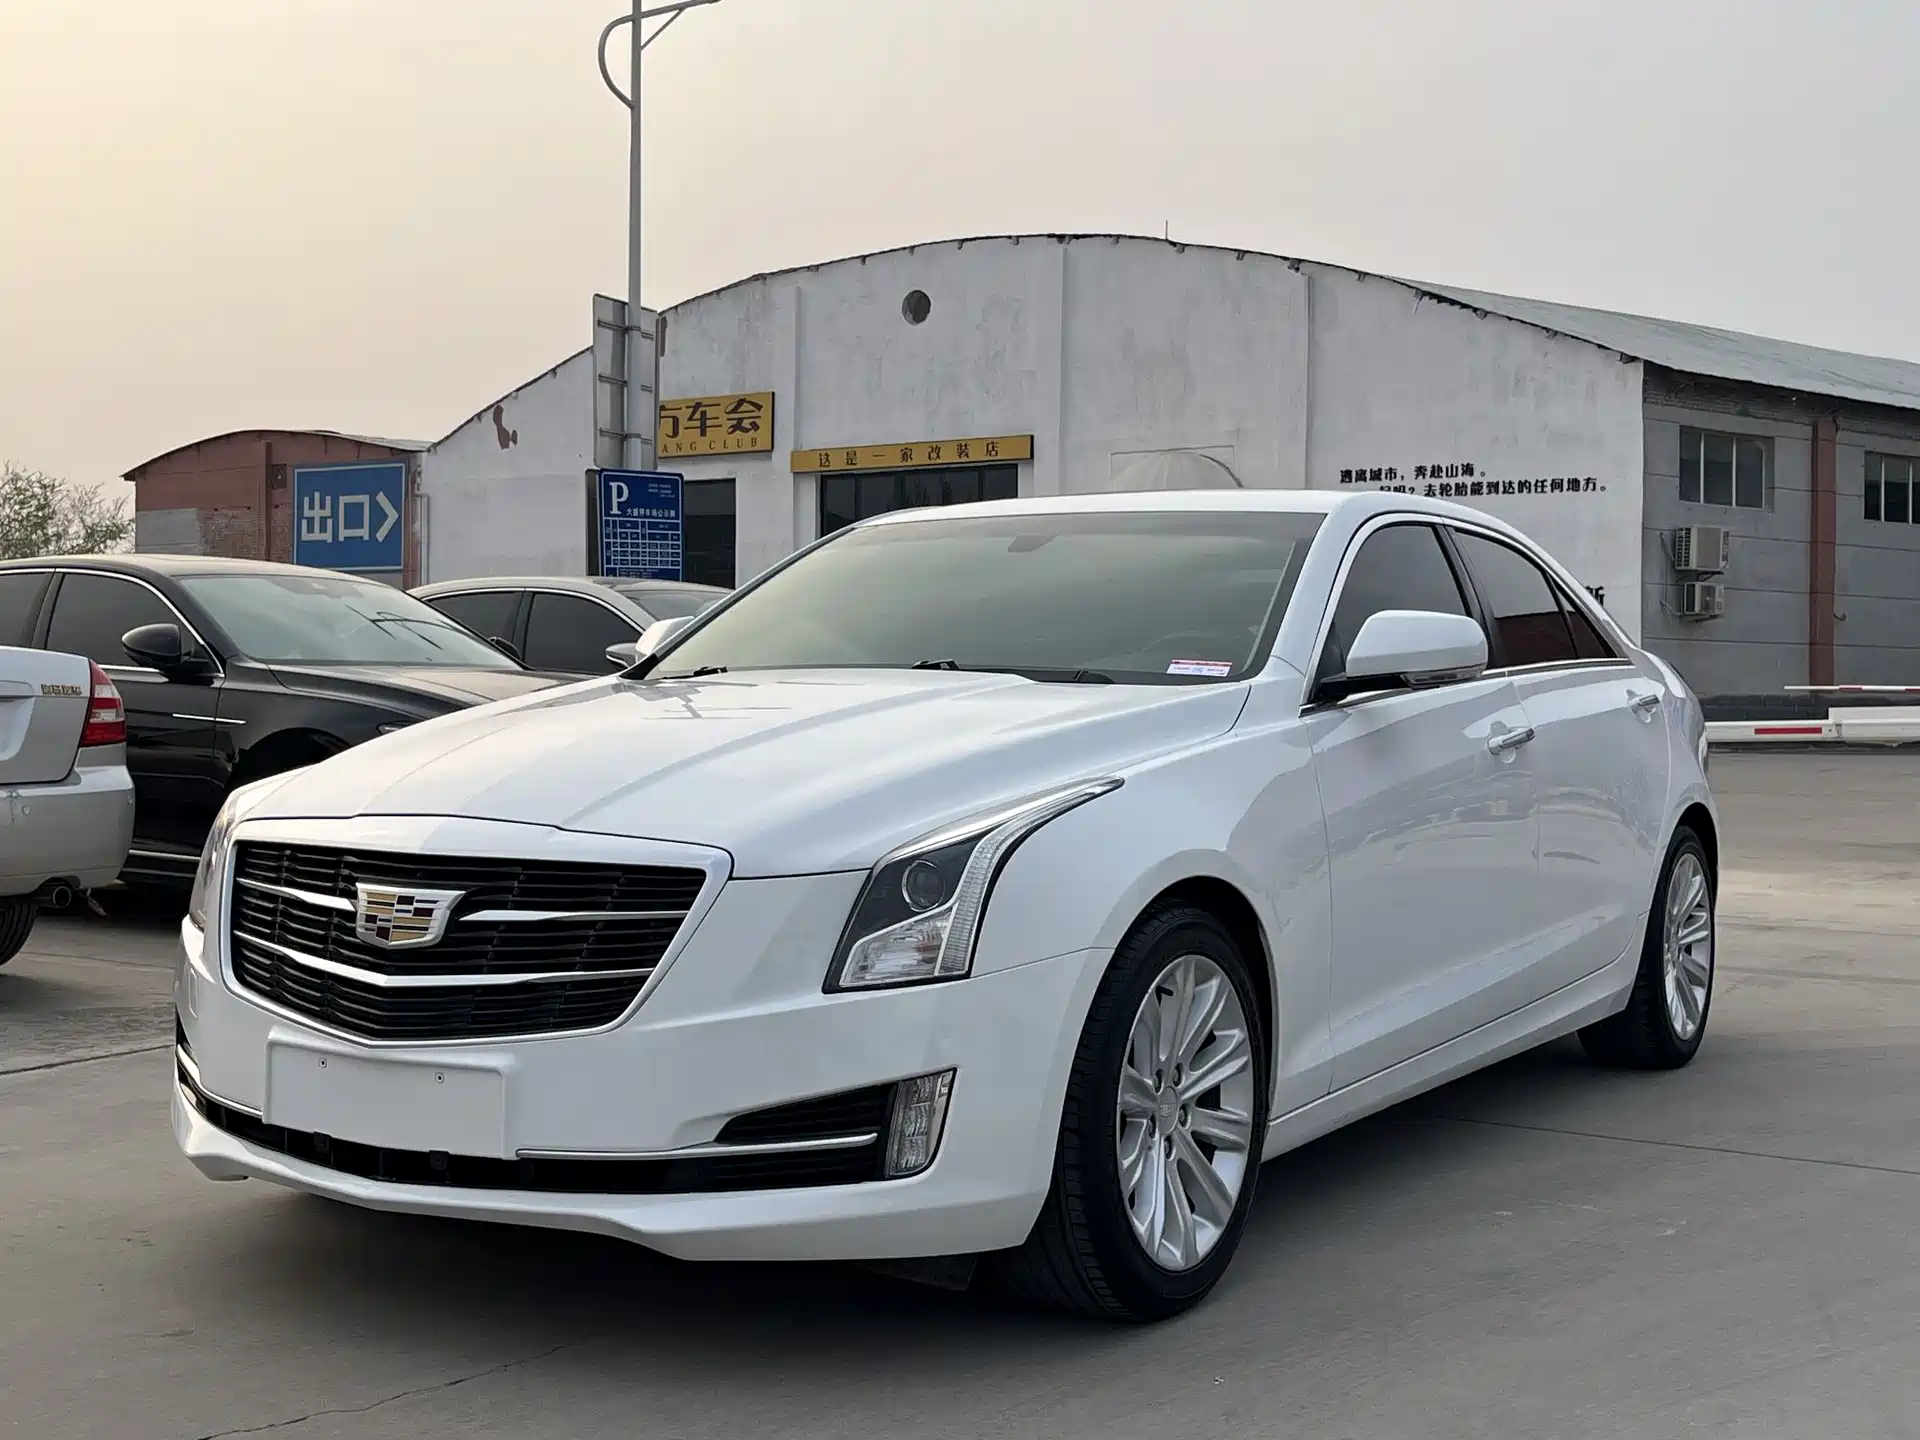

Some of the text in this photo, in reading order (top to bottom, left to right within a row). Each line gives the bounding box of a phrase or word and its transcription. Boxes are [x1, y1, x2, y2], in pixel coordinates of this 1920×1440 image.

[708, 437, 758, 450] CLUB
[818, 440, 1001, 468] 这是一家改装店
[608, 481, 629, 515] P
[301, 491, 370, 543] 出口
